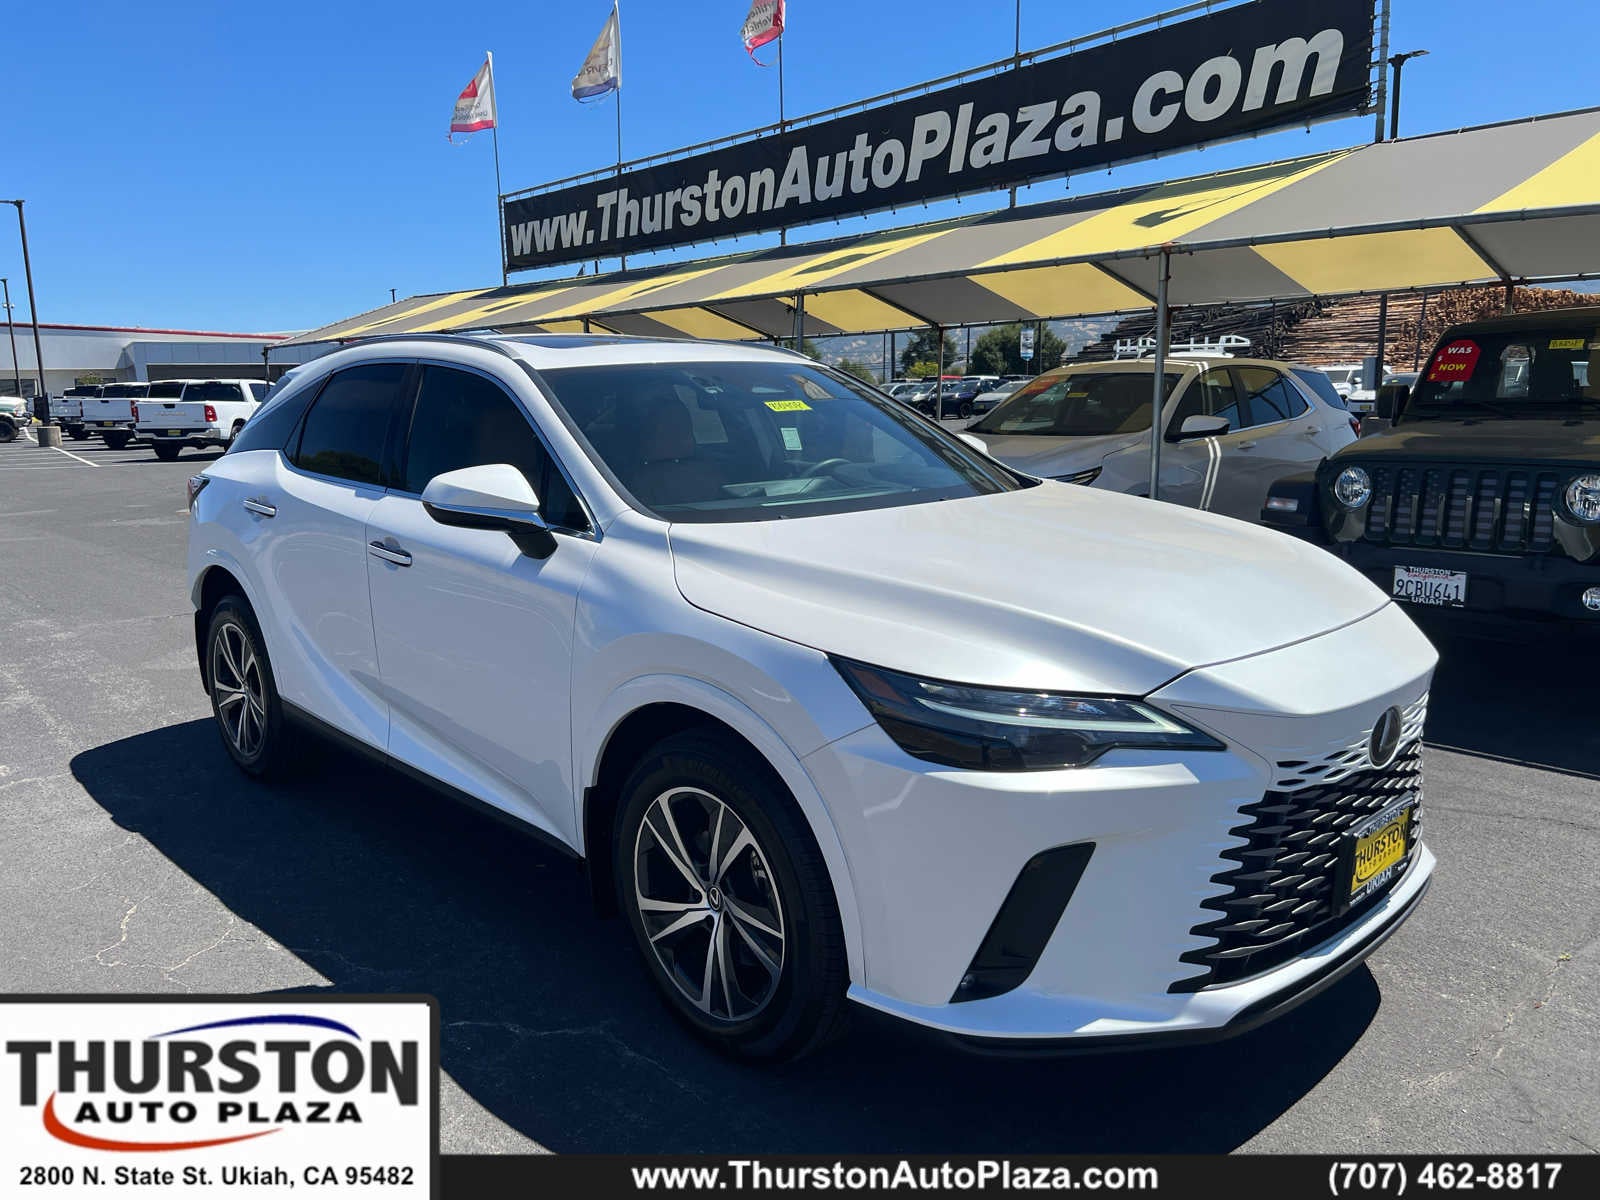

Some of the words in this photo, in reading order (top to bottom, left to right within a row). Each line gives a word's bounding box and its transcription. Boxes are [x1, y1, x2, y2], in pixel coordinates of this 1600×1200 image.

[511, 28, 1344, 257] www.ThurstonAutoPlaza.com
[1447, 346, 1473, 355] WAS
[1438, 363, 1467, 371] NOW
[1408, 566, 1451, 576] THURSTON
[1396, 578, 1459, 601] 9CBU641
[1411, 596, 1443, 606] UKIAH
